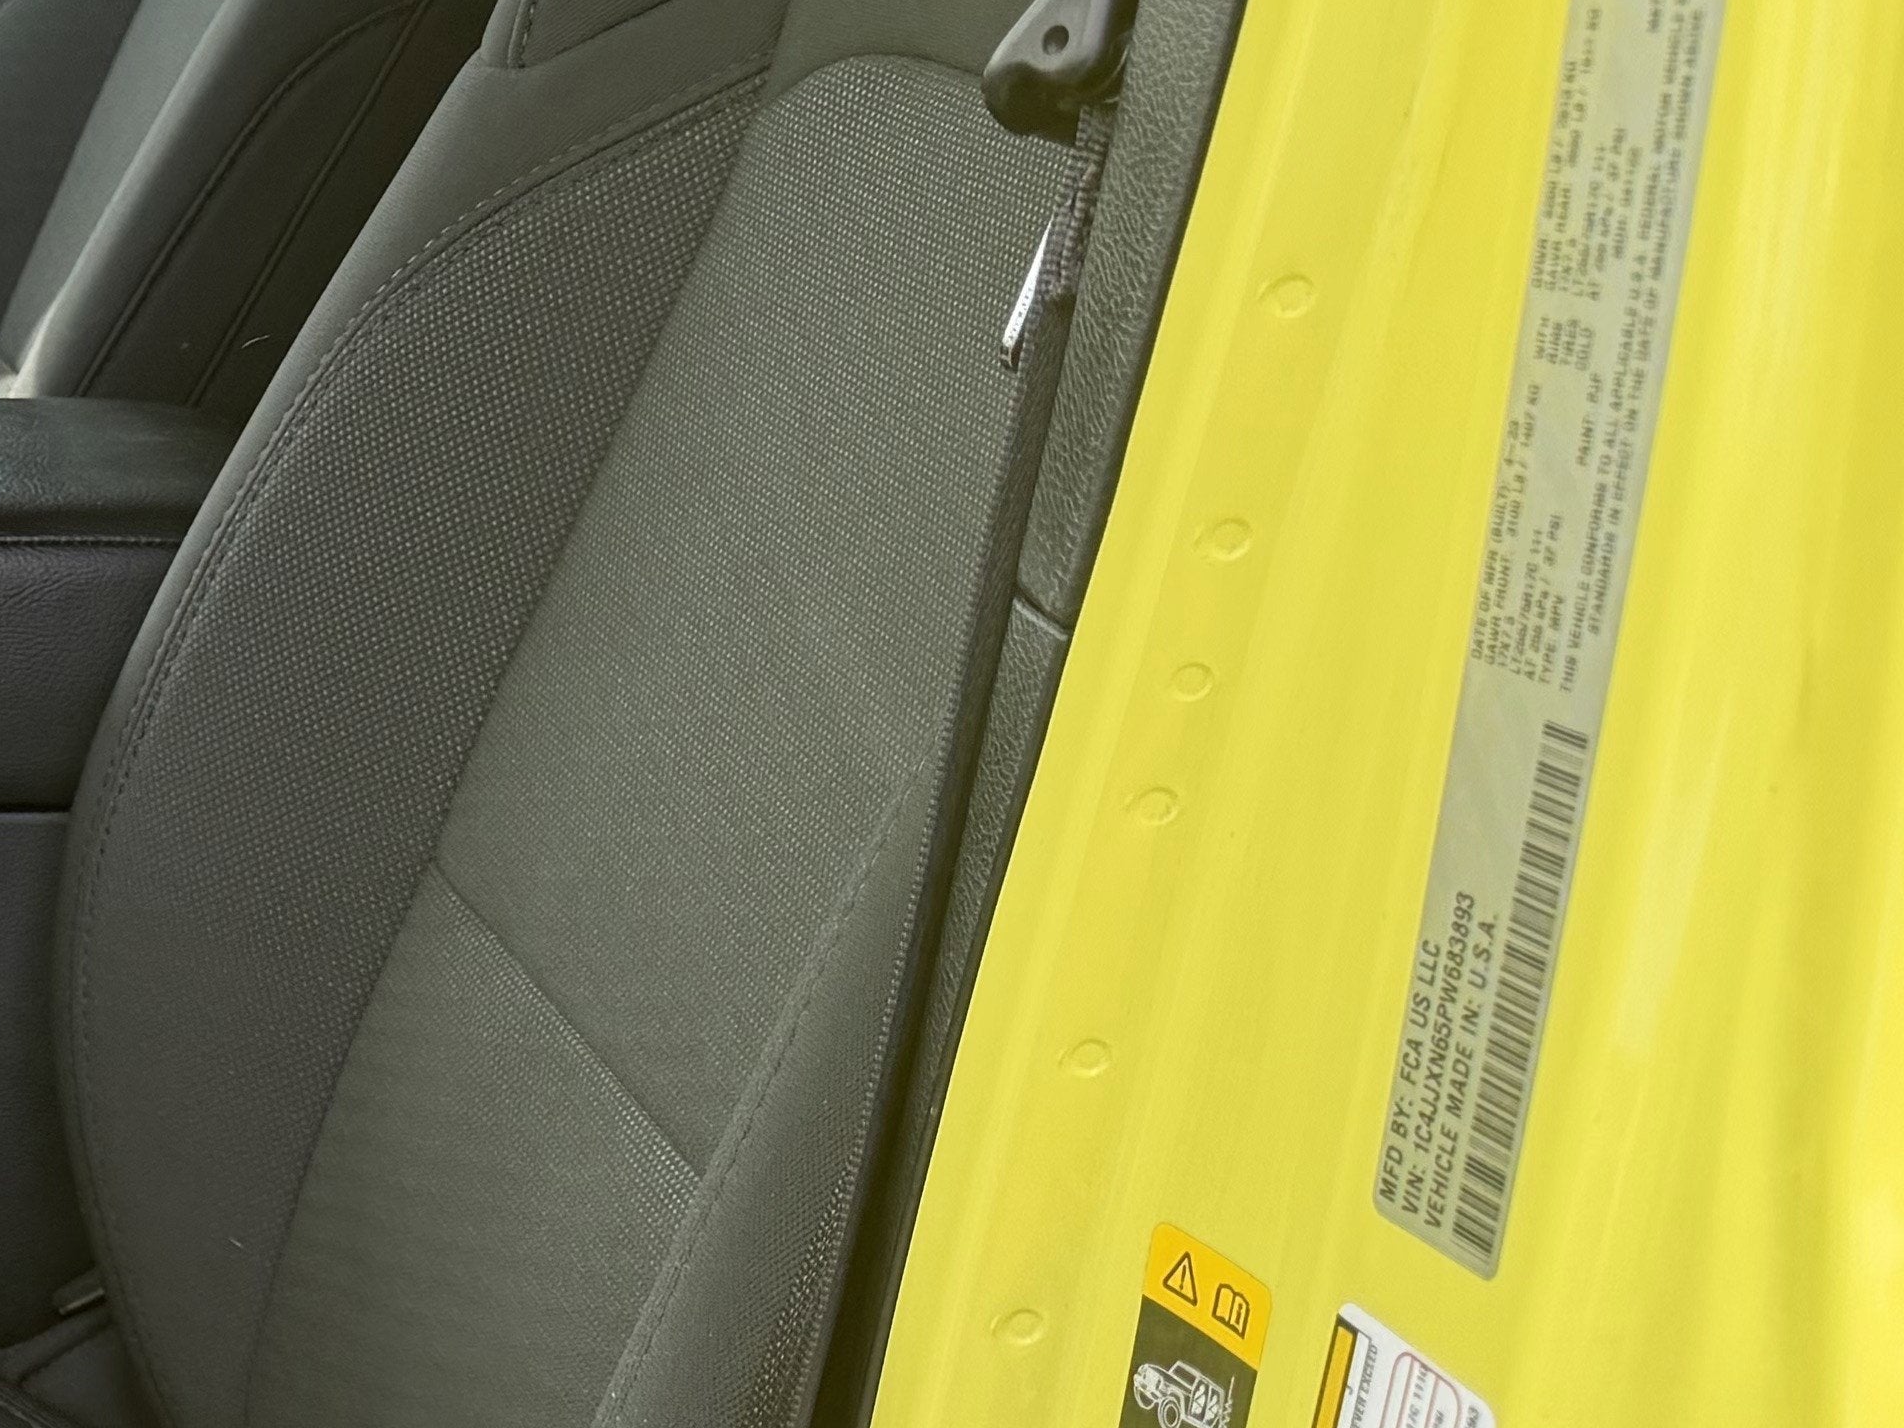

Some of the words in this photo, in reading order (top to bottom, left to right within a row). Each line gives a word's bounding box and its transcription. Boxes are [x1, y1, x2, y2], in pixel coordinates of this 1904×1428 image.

[1417, 937, 1440, 986] LLC
[1467, 909, 1496, 989] U.S.A.
[1409, 990, 1430, 1031] US
[1460, 996, 1480, 1036] IN:
[1400, 1033, 1423, 1086] FCA
[1445, 1041, 1472, 1118] MADE
[1390, 1092, 1412, 1139] BY:
[1379, 1144, 1403, 1203] MFD
[1401, 1162, 1425, 1219] VIN:
[1424, 1123, 1458, 1231] VEHICLE
